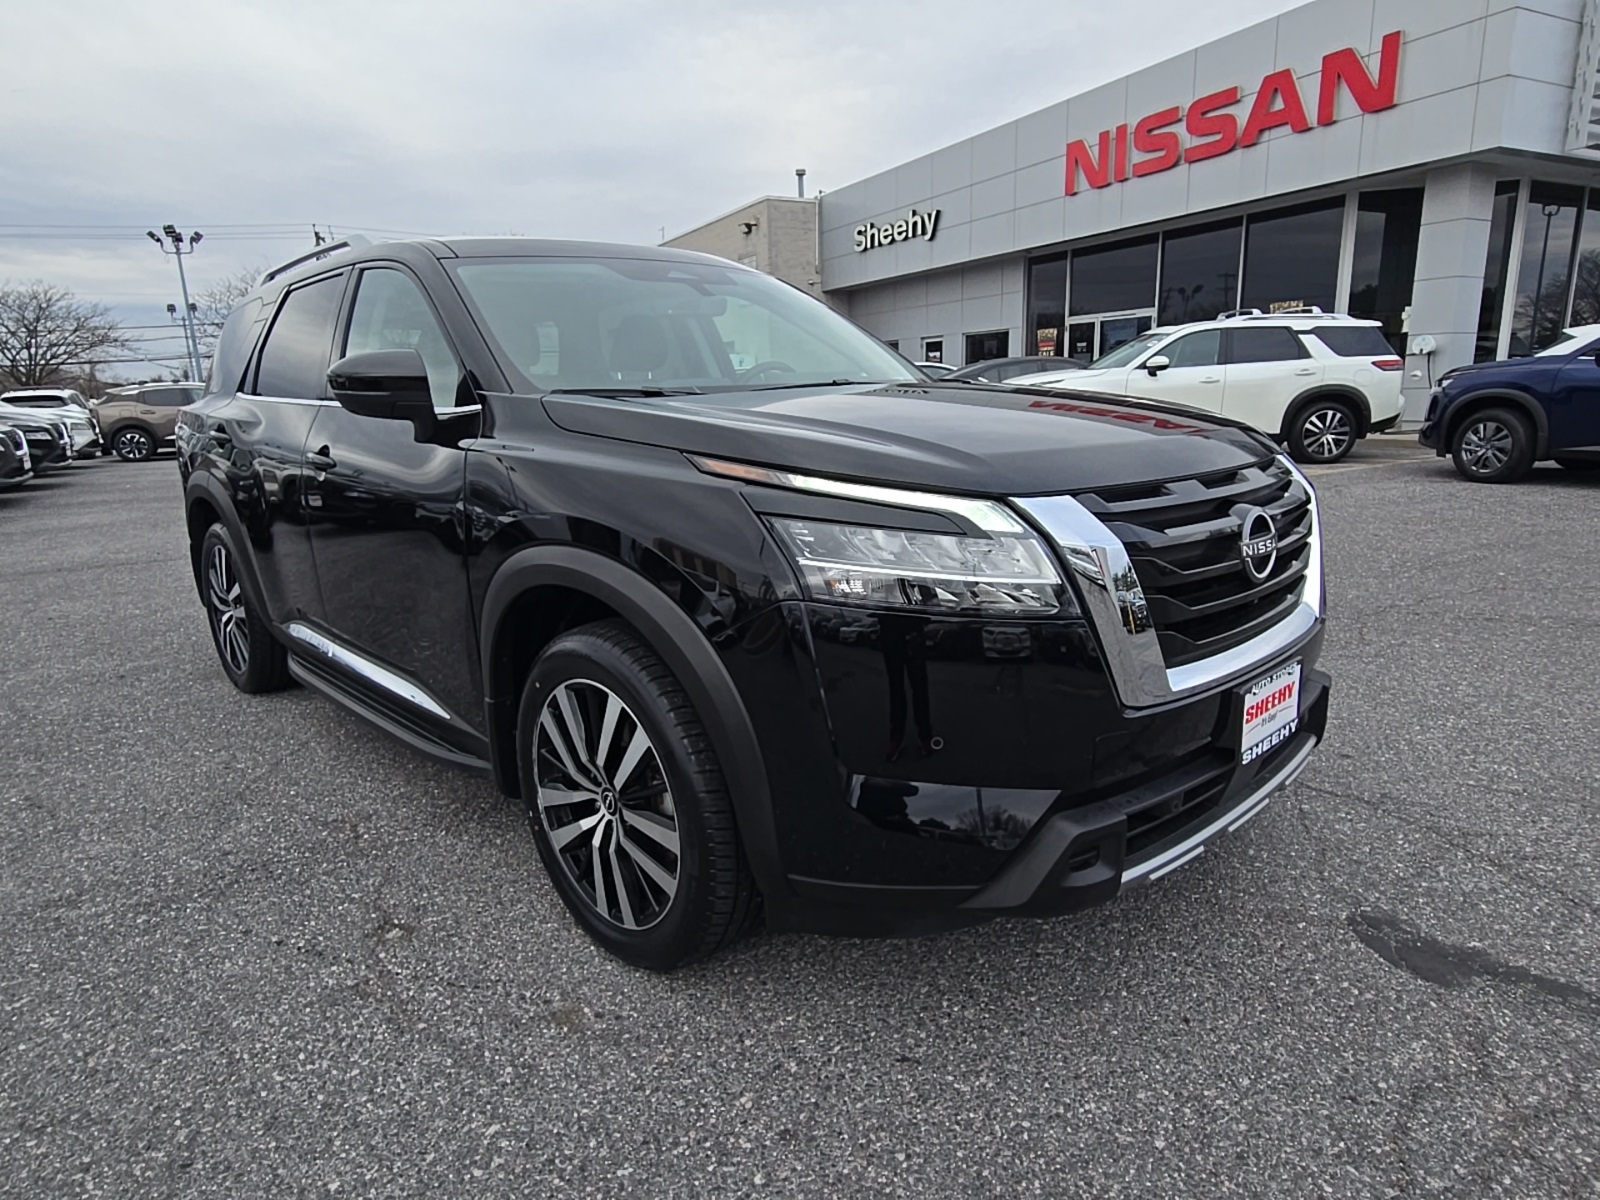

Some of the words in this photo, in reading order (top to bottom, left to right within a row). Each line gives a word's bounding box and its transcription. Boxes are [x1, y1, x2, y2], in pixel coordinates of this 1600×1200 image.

[1064, 30, 1403, 196] NISSAN
[853, 208, 941, 253] Sheehy
[1242, 538, 1276, 557] NISSA
[1245, 681, 1295, 725] SHEEHY
[1242, 718, 1298, 765] SHEEHY
